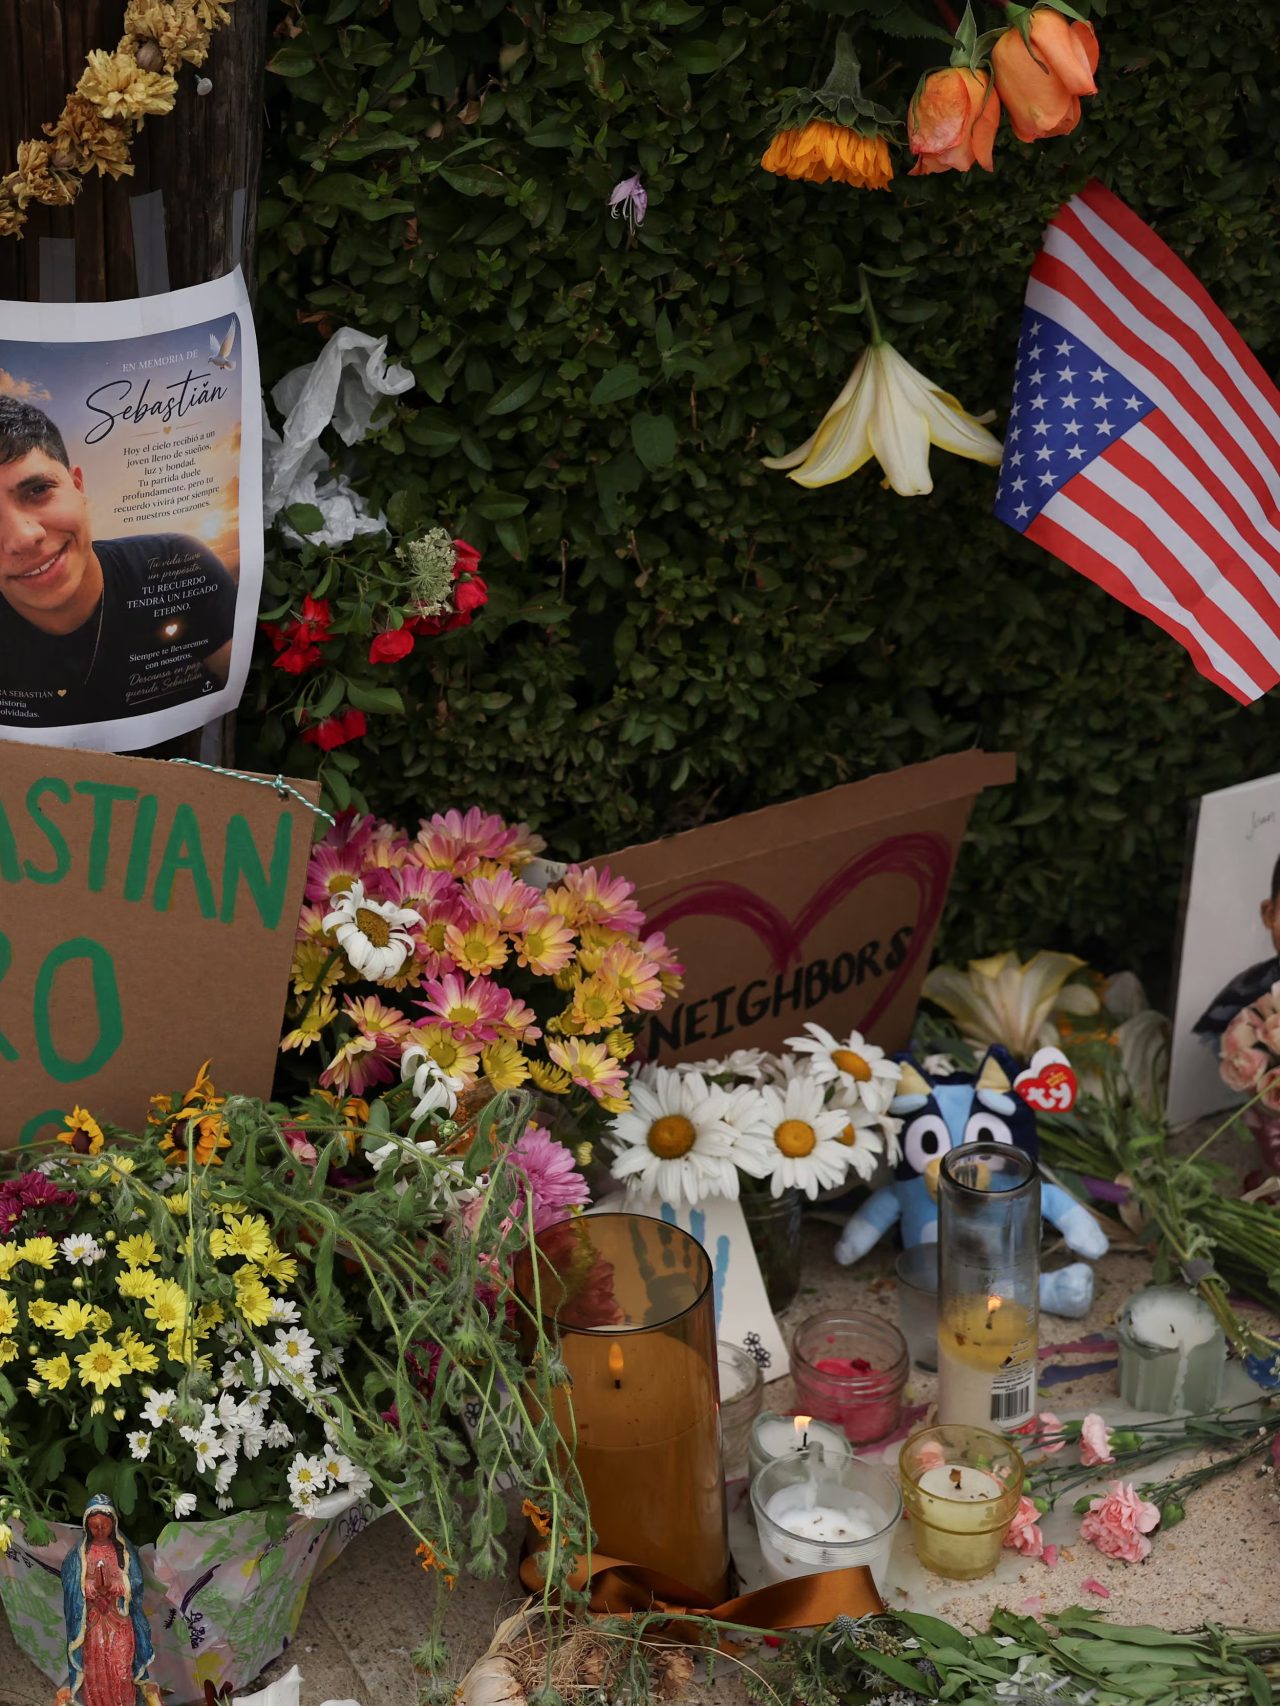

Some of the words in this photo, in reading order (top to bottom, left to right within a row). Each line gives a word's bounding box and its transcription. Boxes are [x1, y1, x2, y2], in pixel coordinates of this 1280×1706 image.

[122, 363, 136, 373] EN
[139, 353, 185, 371] MEMORIA
[186, 349, 198, 359] DE
[123, 447, 141, 456] Hoy
[142, 444, 150, 452] el
[152, 441, 171, 451] cielo
[173, 434, 199, 446] recibió
[206, 430, 216, 438] un
[126, 456, 149, 469] joven
[151, 454, 172, 463] lleno
[173, 450, 182, 459] de
[144, 467, 157, 476] luz
[166, 458, 196, 471] bondad.
[138, 479, 149, 487] Tu
[151, 474, 179, 488] partida
[181, 468, 201, 479] duele
[113, 501, 151, 513] recuerdo
[152, 497, 175, 508] vivirá
[176, 494, 191, 505] por
[191, 485, 220, 500] siempre
[122, 485, 186, 502] profundamente,
[187, 480, 205, 491] pero
[206, 476, 214, 484] tu
[123, 516, 134, 524] en
[135, 509, 171, 521] nuestros
[146, 556, 160, 569] Tu
[162, 553, 181, 566] vida
[141, 585, 155, 595] TU
[157, 575, 206, 593] RECUERDO
[126, 595, 165, 609] TENDRÁ
[167, 593, 180, 603] UN
[182, 583, 219, 599] LEGADO
[153, 602, 191, 618] ETERNO.
[129, 650, 160, 662] Siempre
[170, 638, 209, 653] llevaremos
[145, 662, 159, 670] con
[160, 652, 193, 666] nosotros.
[0, 707, 40, 718] olvidadas.
[646, 925, 916, 1062] NEIGHBORS
[1026, 1083, 1072, 1109] ty
